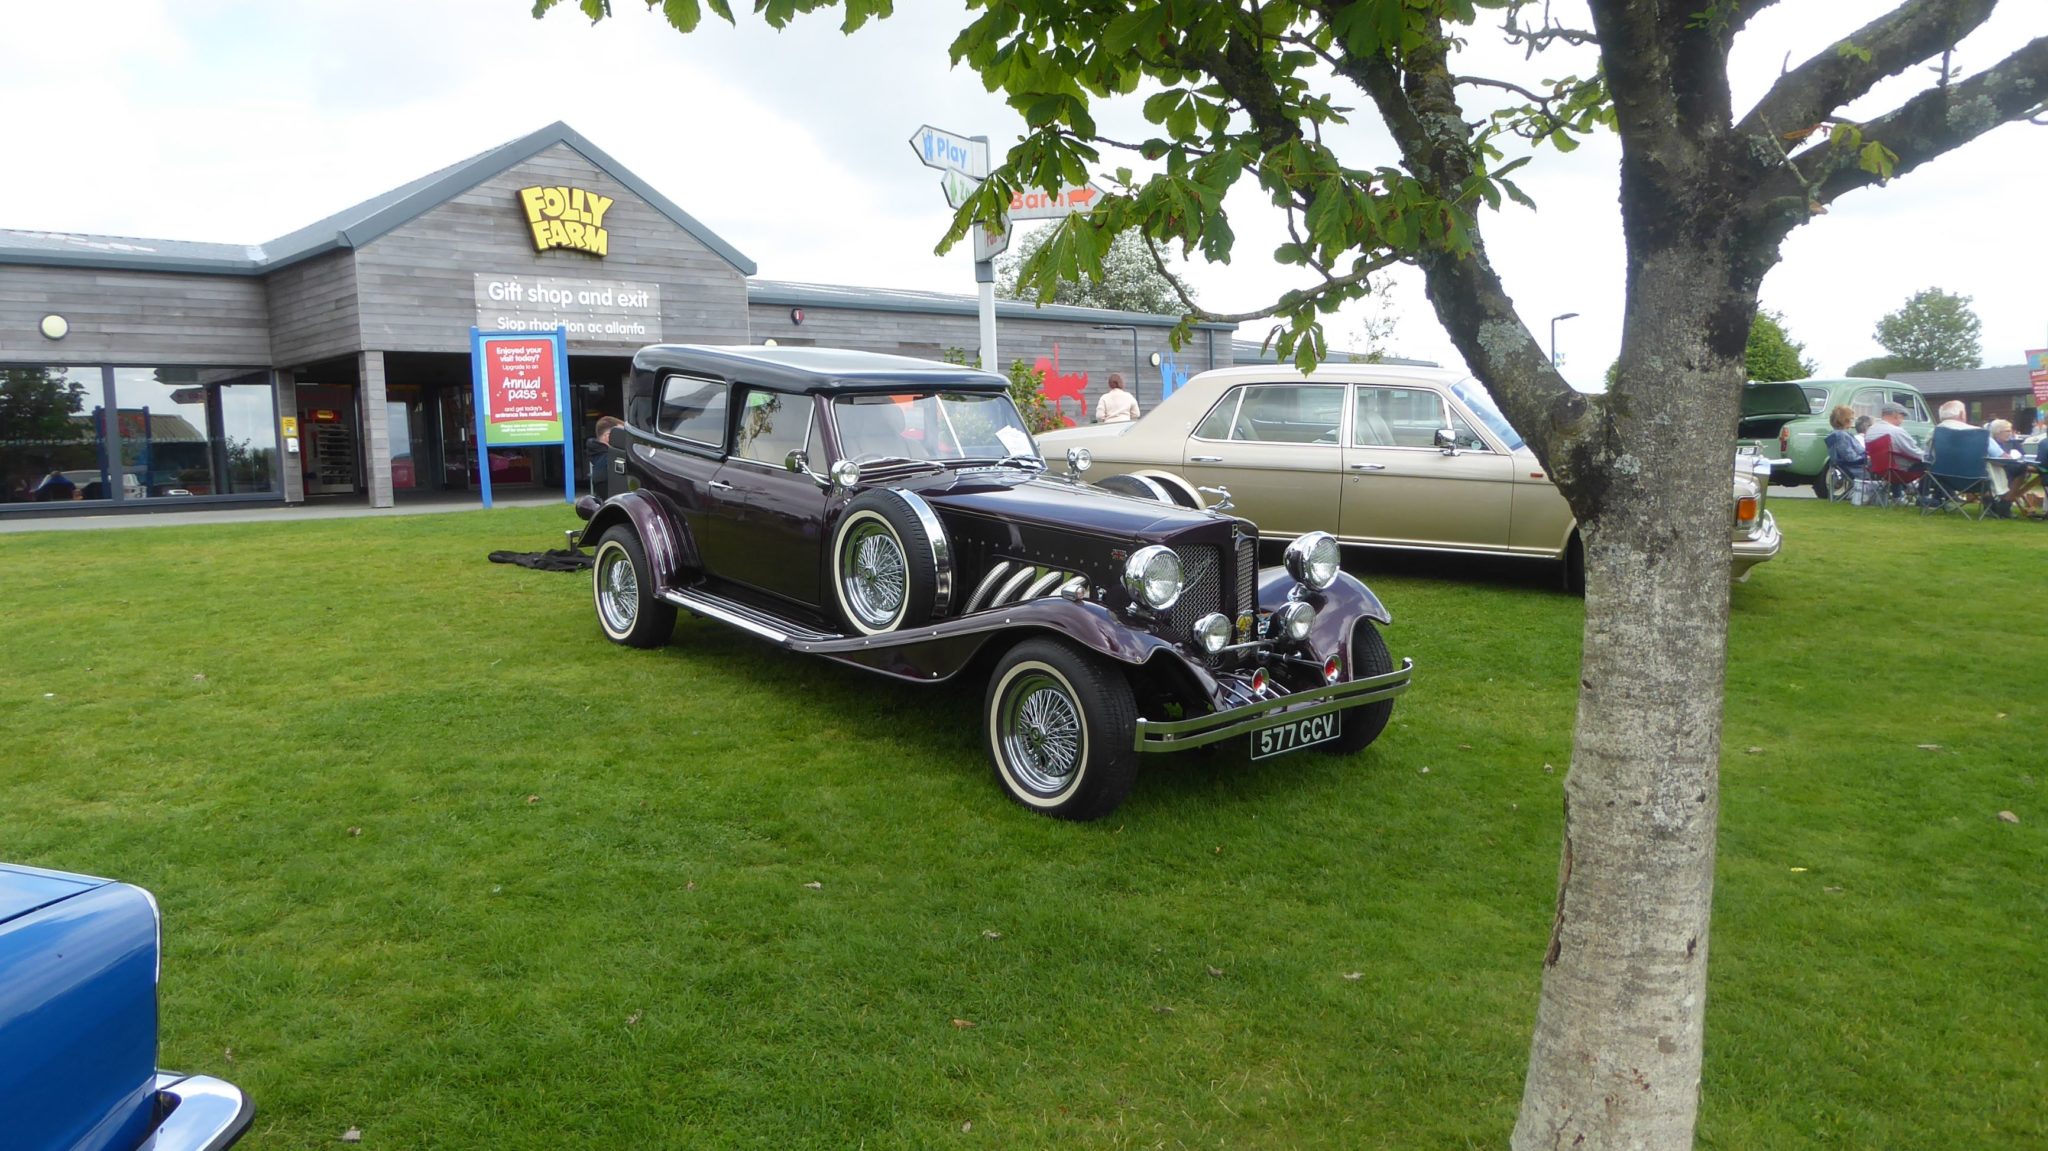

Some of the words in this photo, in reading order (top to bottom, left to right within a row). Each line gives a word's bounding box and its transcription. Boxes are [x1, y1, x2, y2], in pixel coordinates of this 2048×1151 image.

[937, 137, 967, 169] Play
[521, 186, 613, 228] FOLLY
[532, 220, 608, 256] FARM
[488, 282, 523, 301] Gift
[527, 284, 573, 308] shop
[577, 288, 613, 306] and
[617, 290, 649, 308] exit
[497, 317, 526, 332] Siop
[588, 323, 603, 333] ac
[605, 321, 645, 335] allanfa
[496, 346, 525, 356] Enjoyed
[525, 347, 543, 356] your
[515, 354, 541, 363] today?
[503, 376, 541, 389] Annual
[508, 389, 538, 402] pass
[1261, 723, 1297, 753] 577
[1300, 714, 1333, 743] CCV
